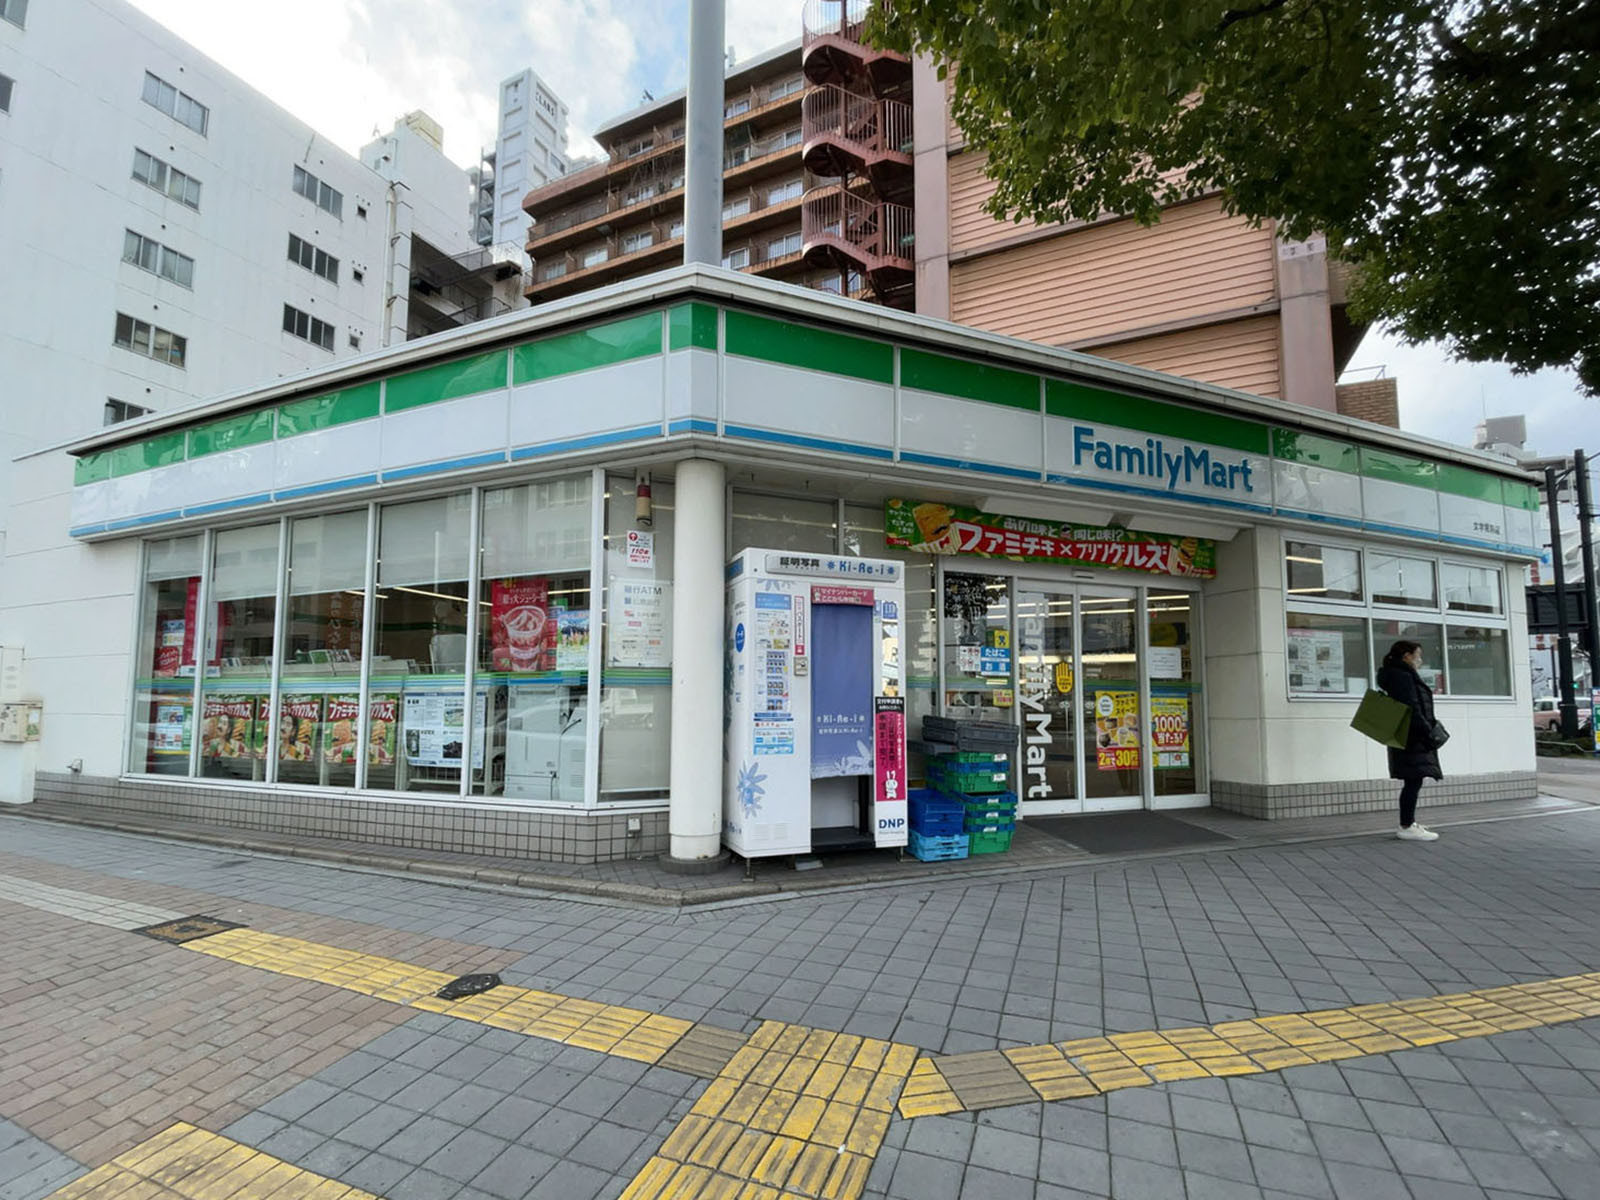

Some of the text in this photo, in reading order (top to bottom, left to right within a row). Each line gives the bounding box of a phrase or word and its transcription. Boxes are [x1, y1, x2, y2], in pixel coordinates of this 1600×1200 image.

[1072, 425, 1253, 493] FamilyMart
[1003, 517, 1058, 537] あの味と
[780, 556, 820, 568] 証明写真
[985, 648, 1006, 657] たばこ
[878, 818, 905, 829] DNP
